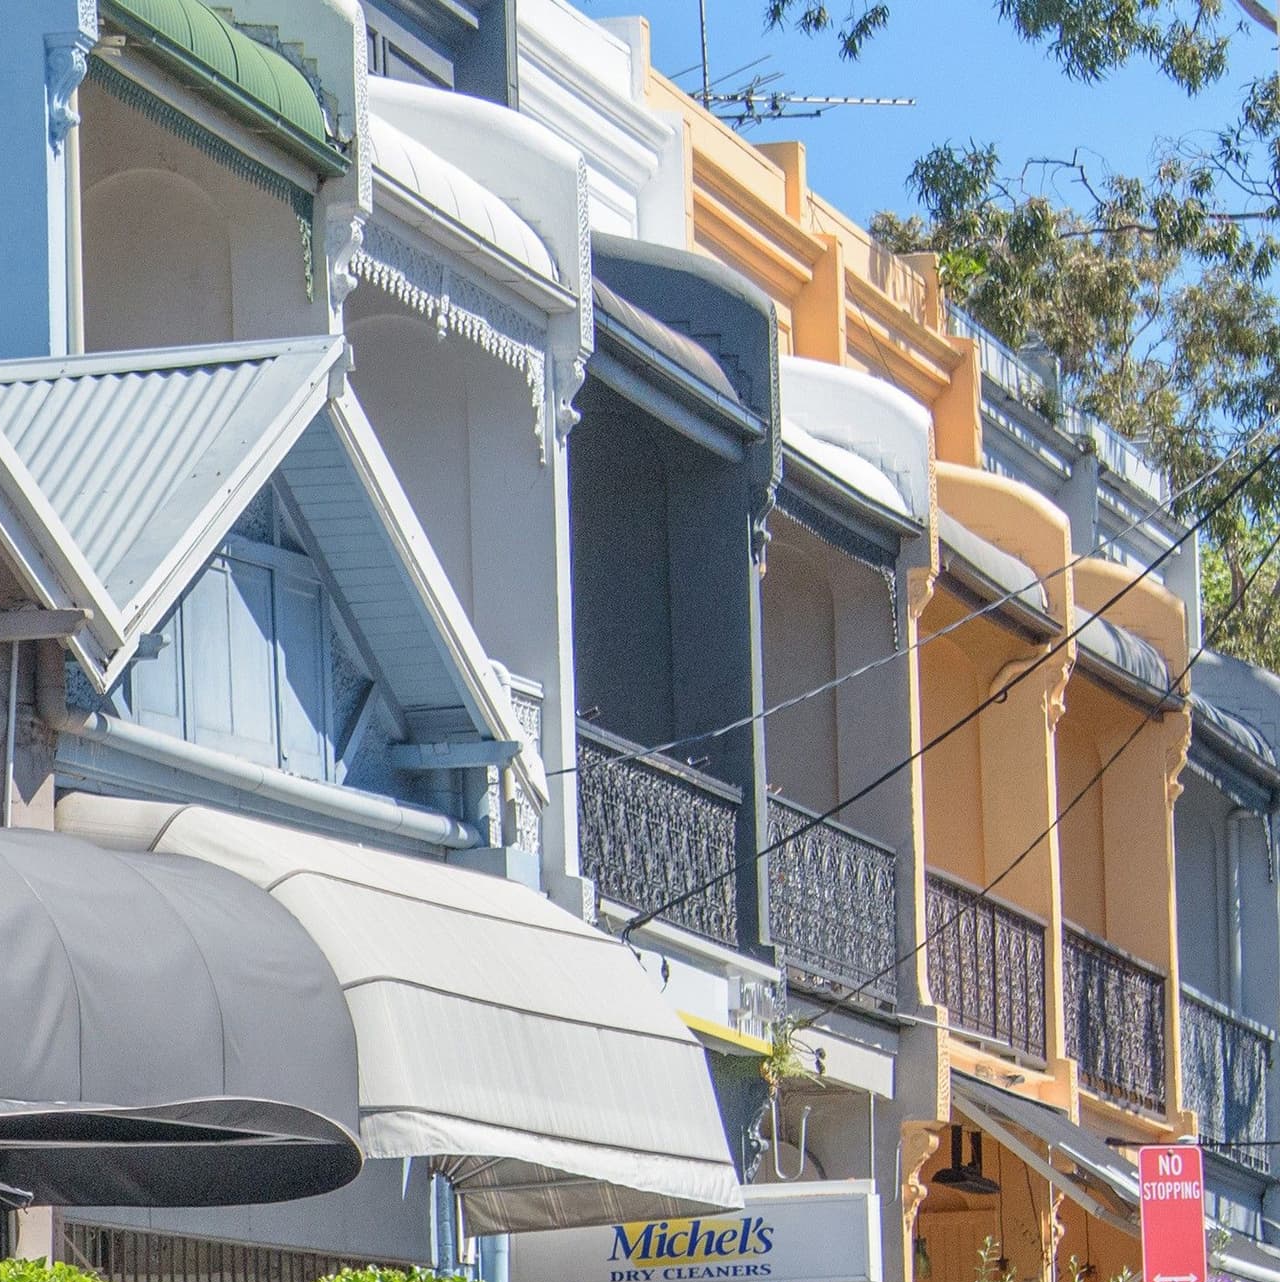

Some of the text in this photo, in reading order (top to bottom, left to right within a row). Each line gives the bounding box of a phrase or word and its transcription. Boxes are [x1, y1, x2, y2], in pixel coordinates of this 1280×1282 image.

[1158, 1154, 1182, 1176] NO
[1143, 1181, 1200, 1201] STOPPING
[607, 1217, 774, 1262] Michel's
[610, 1263, 772, 1282] DRY CLEANERS
